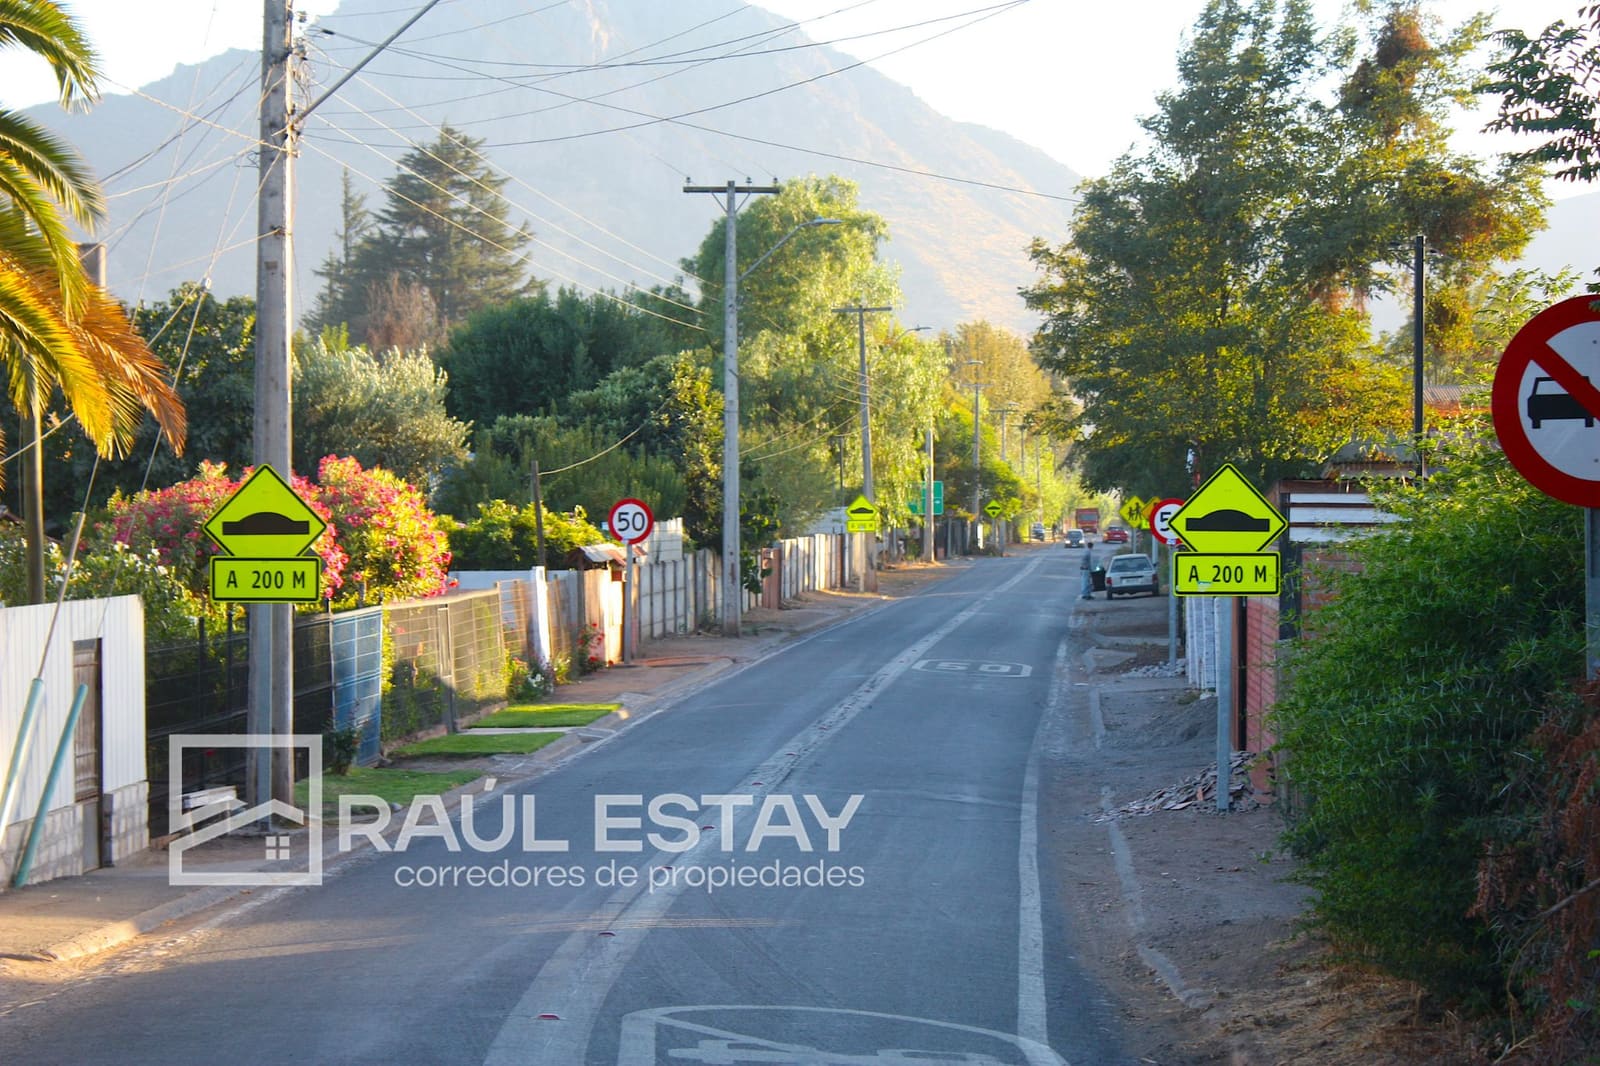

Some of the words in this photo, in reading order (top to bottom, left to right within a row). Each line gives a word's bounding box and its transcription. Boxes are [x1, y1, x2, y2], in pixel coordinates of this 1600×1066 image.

[618, 512, 645, 532] 50
[227, 570, 239, 588] A
[252, 570, 284, 589] 200
[293, 570, 305, 588] M
[1188, 565, 1199, 583] A
[1212, 565, 1244, 583] 200
[1254, 565, 1267, 583] M
